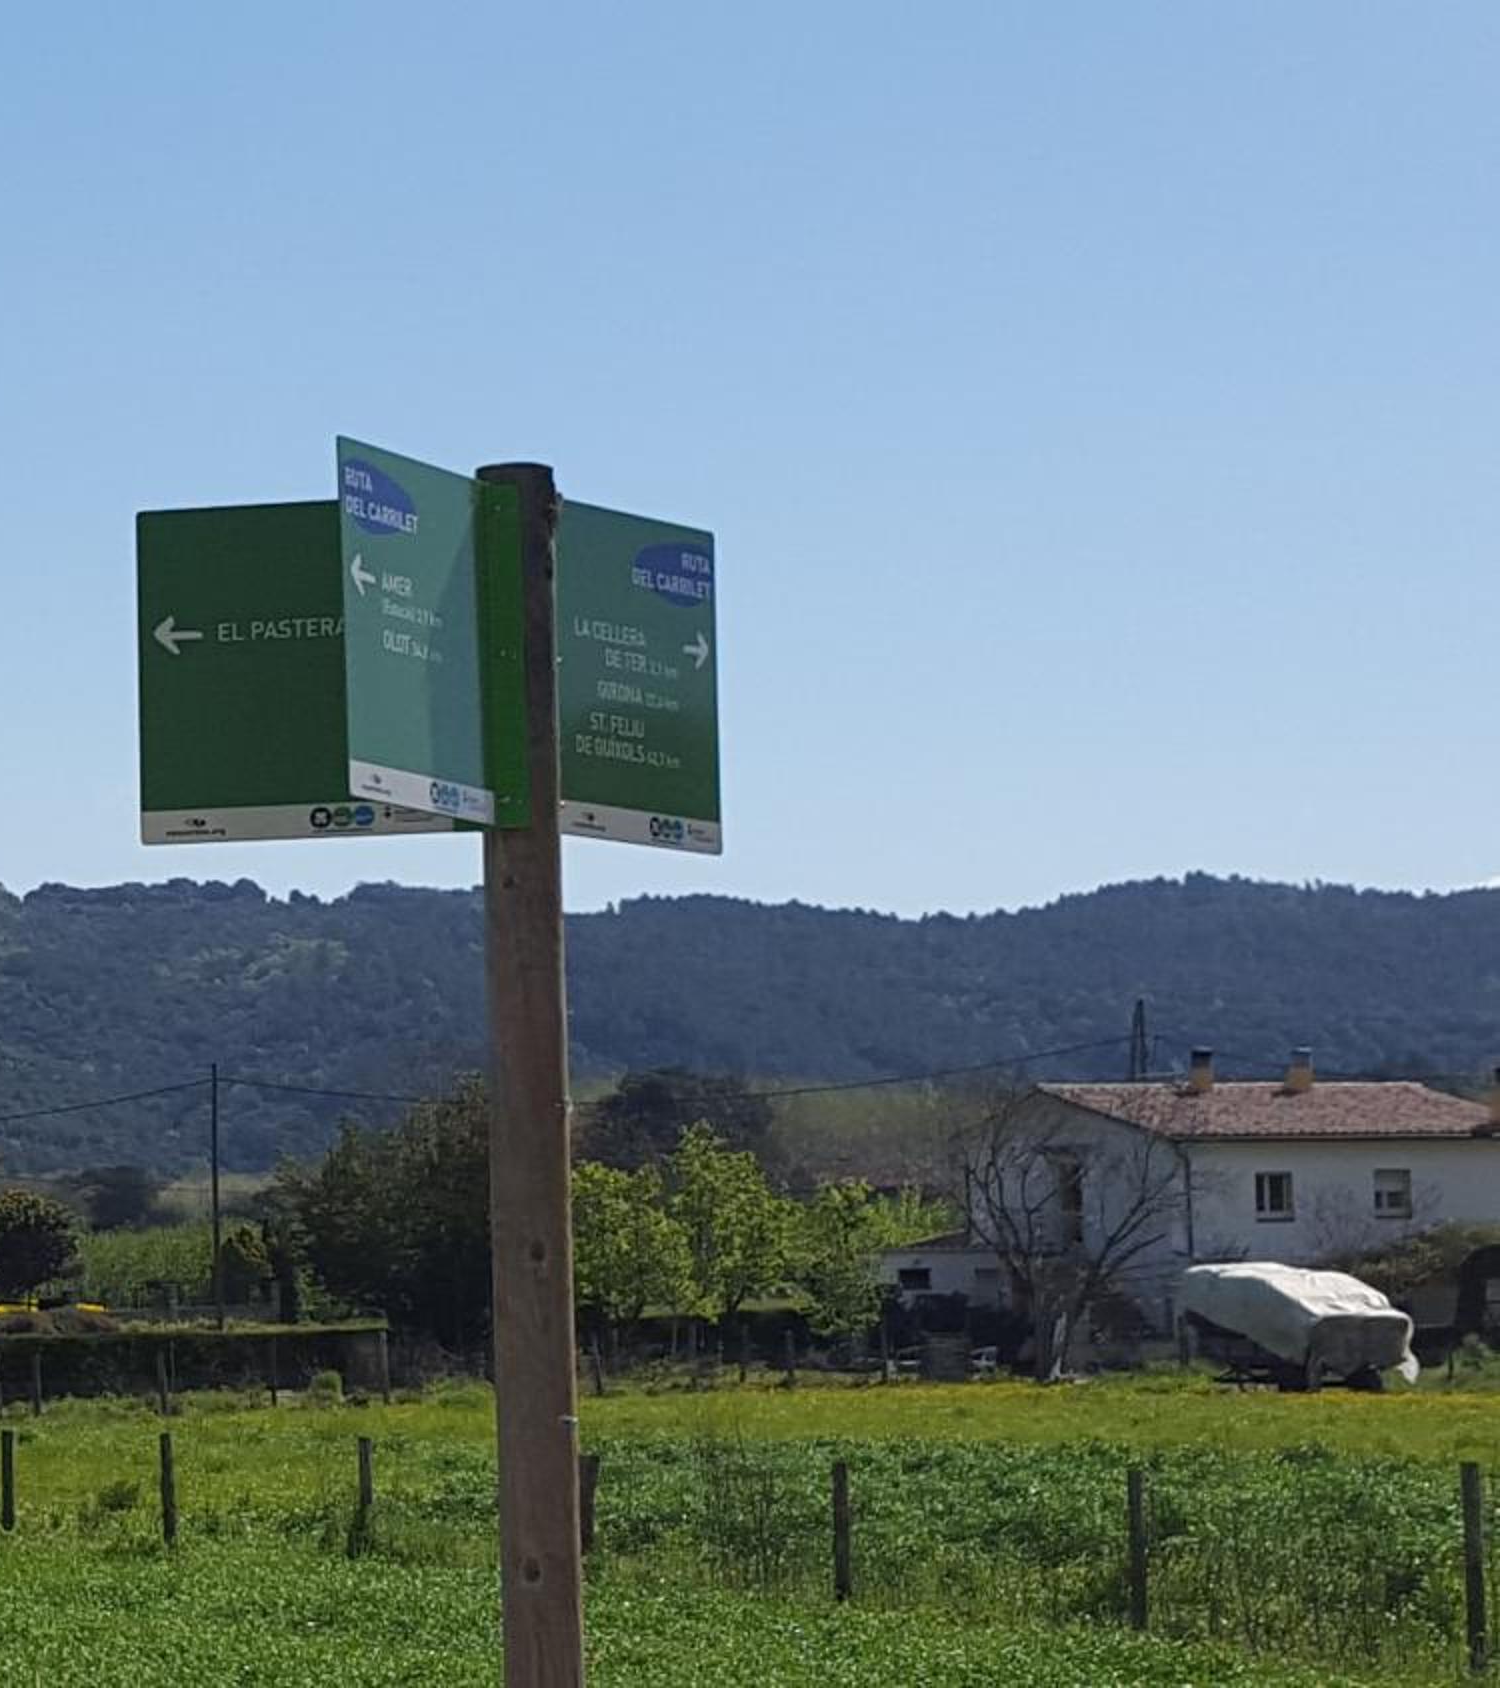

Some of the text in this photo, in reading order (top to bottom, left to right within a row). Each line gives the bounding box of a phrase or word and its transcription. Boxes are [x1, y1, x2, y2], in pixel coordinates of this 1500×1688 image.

[345, 488, 418, 536] DEL CARRILET
[632, 566, 710, 600] DEL CARRILET
[217, 623, 245, 641] EL
